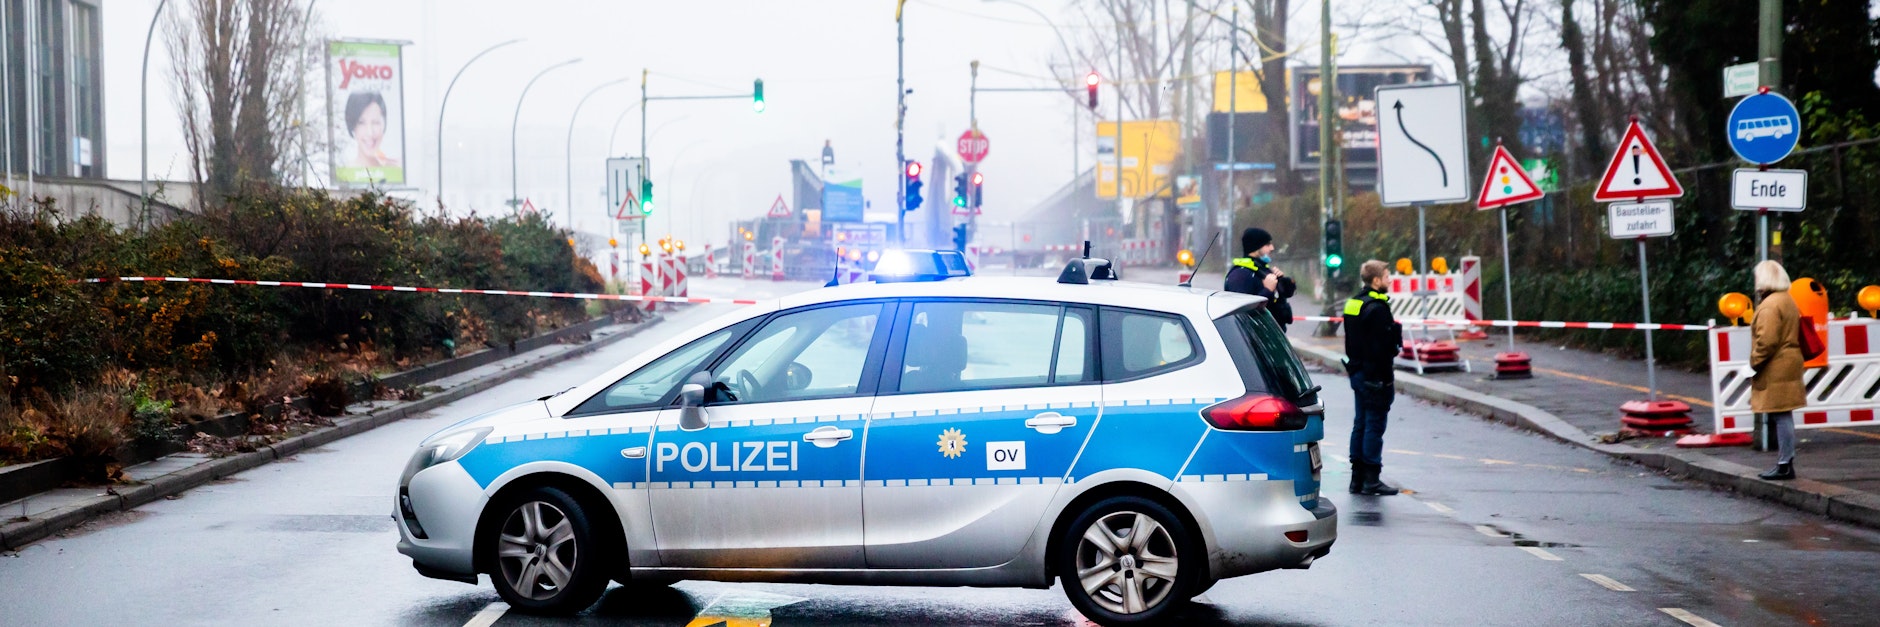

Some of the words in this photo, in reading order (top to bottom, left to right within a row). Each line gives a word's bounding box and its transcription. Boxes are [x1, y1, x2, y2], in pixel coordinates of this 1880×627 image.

[1751, 179, 1786, 197] Ende
[1616, 204, 1665, 217] Baustellen-
[1626, 219, 1657, 231] zufahrt
[656, 441, 798, 473] POLIZEI
[994, 448, 1018, 463] OV
